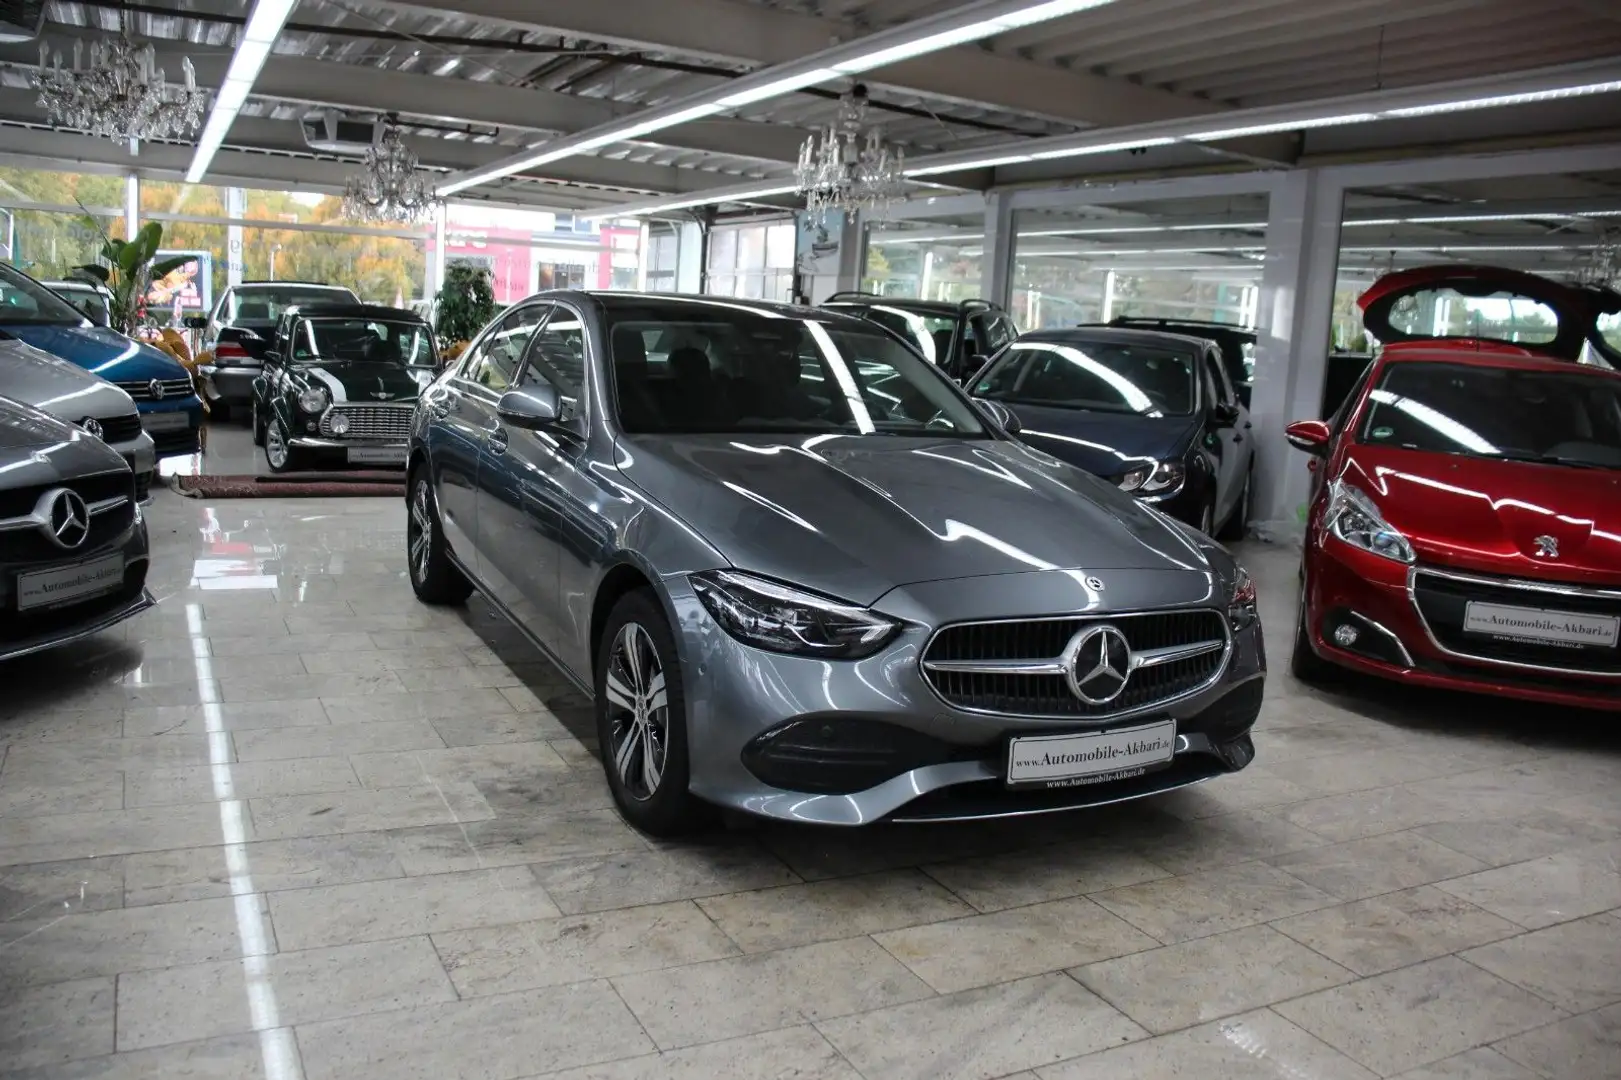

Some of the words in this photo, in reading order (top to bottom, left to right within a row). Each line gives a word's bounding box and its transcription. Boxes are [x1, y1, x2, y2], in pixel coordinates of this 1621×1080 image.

[1470, 615, 1612, 637] www.Automobile-Akbari.de
[1016, 738, 1171, 767] www.Automobile-Akbari.de
[1046, 768, 1146, 788] www.Automobile-Akbari.de
